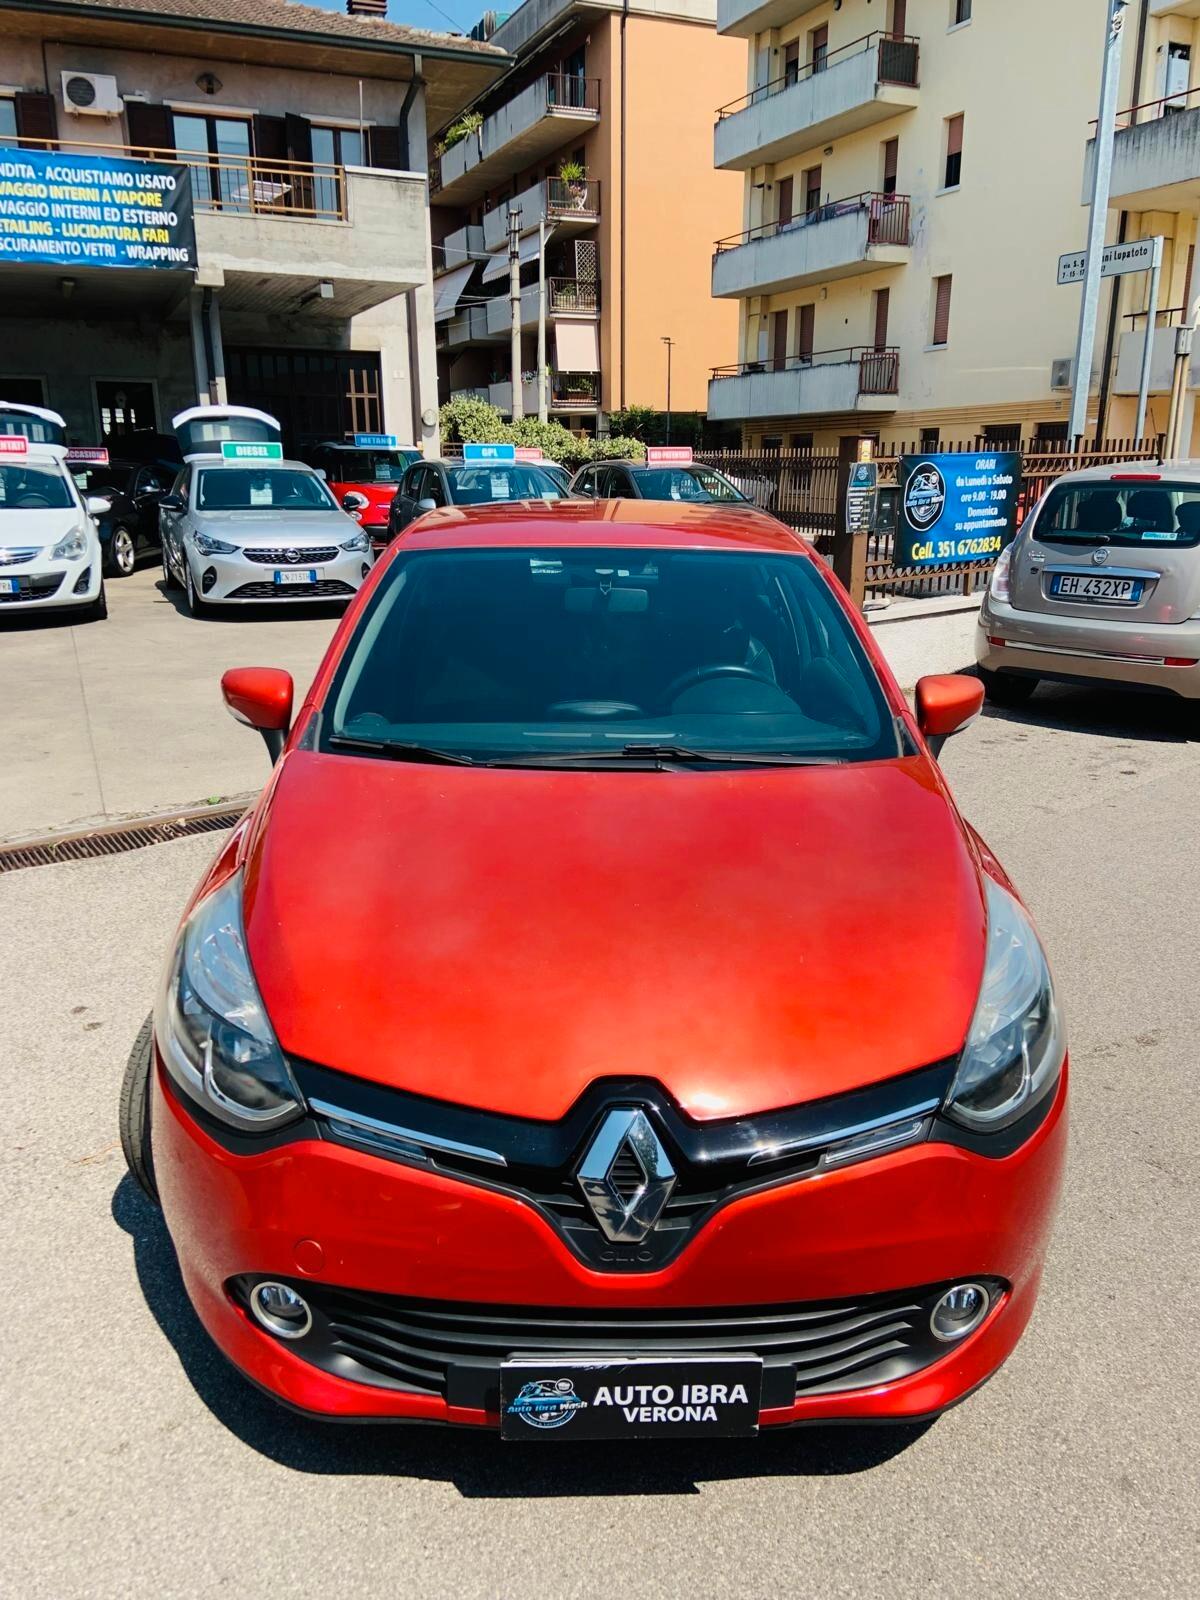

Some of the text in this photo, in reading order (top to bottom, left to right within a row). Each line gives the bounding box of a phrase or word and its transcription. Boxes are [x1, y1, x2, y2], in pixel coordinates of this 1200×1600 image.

[45, 166, 134, 187] ACQUISTIAMO
[135, 173, 177, 191] USATO
[49, 184, 100, 203] INTERNI
[102, 188, 112, 203] A
[112, 189, 163, 208] VAPORE
[51, 203, 101, 220] INTERNI
[103, 207, 121, 223] ED
[122, 208, 178, 227] ESTERNO
[61, 222, 140, 242] LUCIDATURA
[142, 227, 170, 244] FARI
[81, 241, 116, 258] VETRI
[236, 446, 269, 457] DIESEL
[975, 459, 997, 470] ORARI
[967, 506, 998, 518] Domenica
[963, 517, 1008, 532] appuntamento
[911, 536, 1001, 560] Cell. 351 6762834
[593, 1384, 749, 1406] AUTO IBRA
[623, 1405, 718, 1423] VERONA
